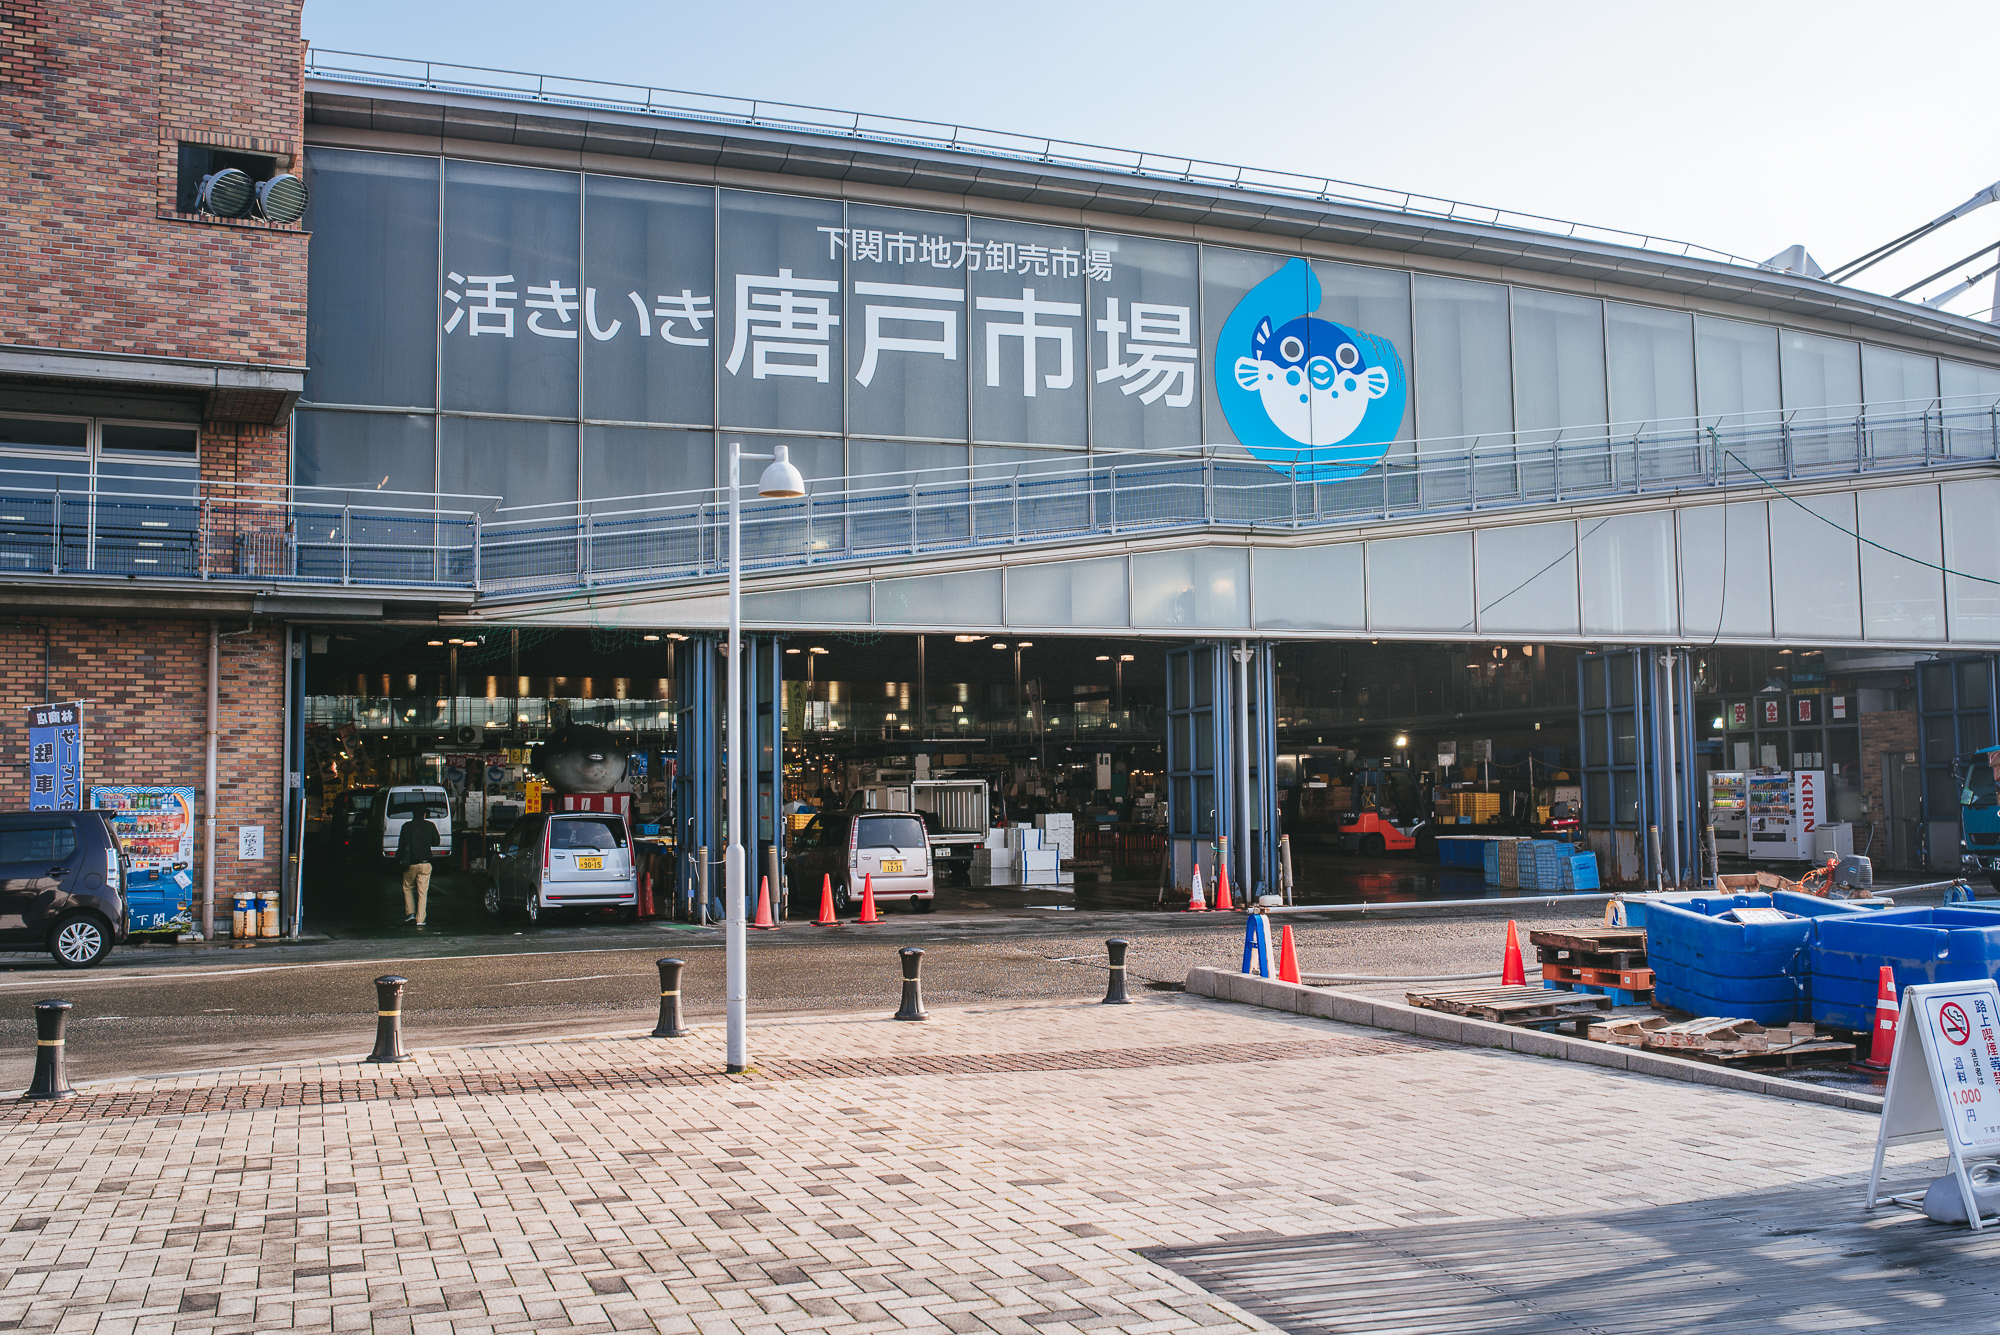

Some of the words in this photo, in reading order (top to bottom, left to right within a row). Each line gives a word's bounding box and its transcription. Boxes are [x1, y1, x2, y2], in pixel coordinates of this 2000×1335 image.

[816, 226, 1113, 282] 下関市地方卸売市場
[443, 270, 715, 347] 活きいき
[724, 268, 1199, 408] 唐戸市場
[1735, 701, 1845, 723] 安全第一
[1801, 774, 1816, 833] KIRIN
[1966, 1108, 1977, 1122] 円
